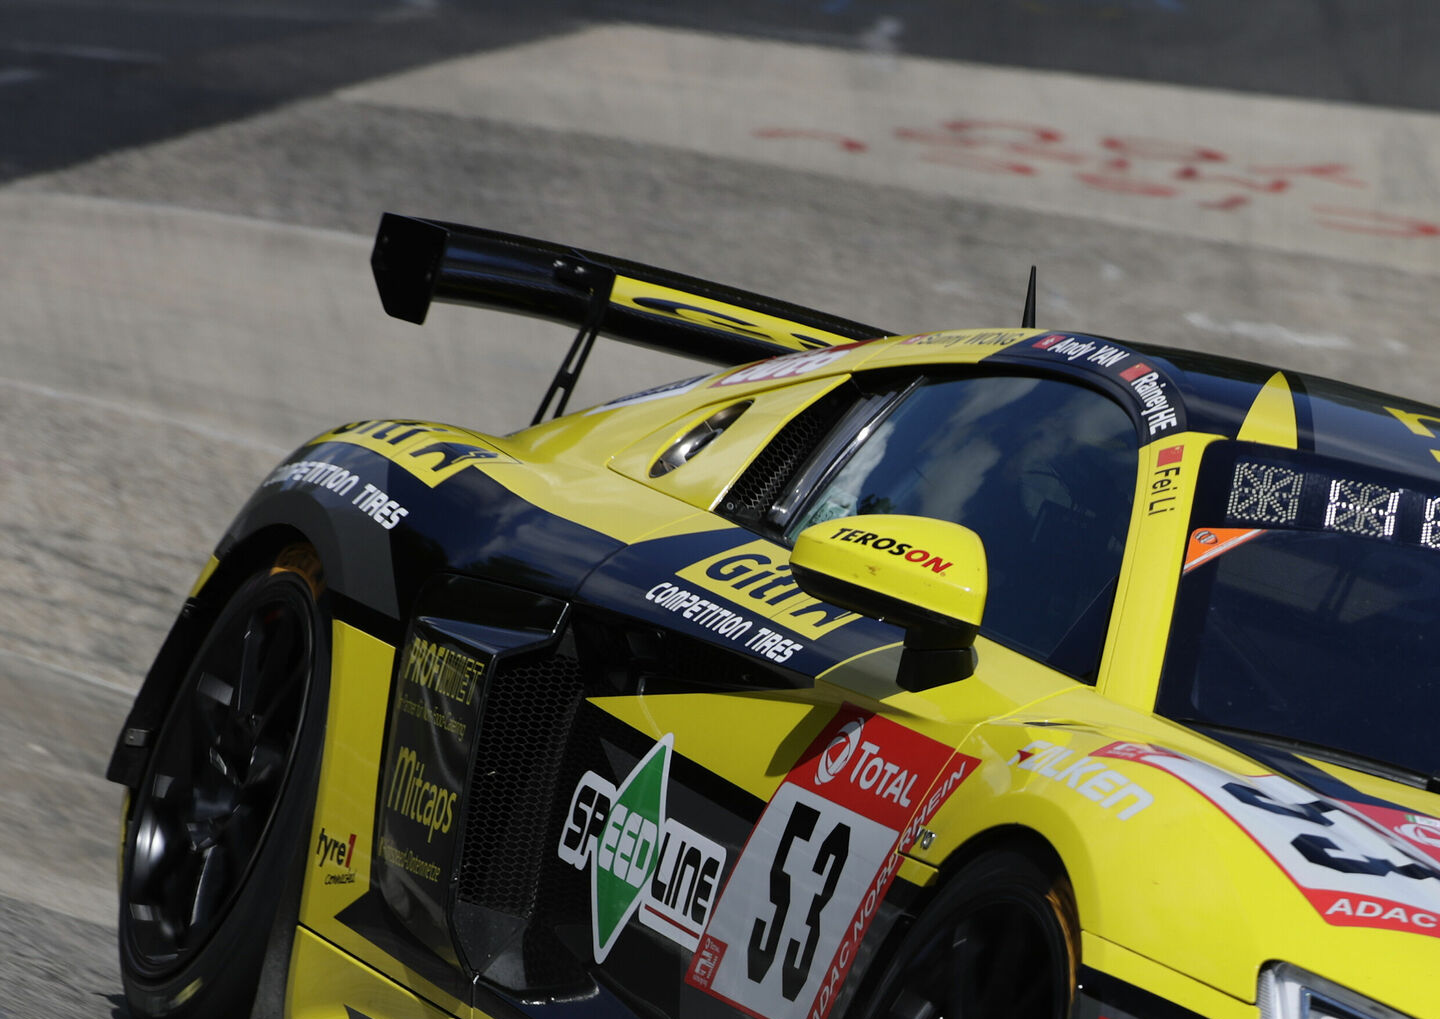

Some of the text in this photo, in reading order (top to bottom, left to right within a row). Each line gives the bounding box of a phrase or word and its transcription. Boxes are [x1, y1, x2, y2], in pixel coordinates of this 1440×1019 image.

[1047, 337, 1130, 368] Andy YAN
[1130, 372, 1178, 435] Rainey HE
[352, 483, 409, 530] TIRES
[1148, 467, 1180, 516] Fei Li
[830, 528, 954, 574] TEROSON
[645, 582, 803, 663] COMPETITION TIRES
[850, 741, 920, 807] TOTAL
[1008, 740, 1154, 821] FALKEN
[747, 801, 851, 1002] 53
[1325, 898, 1437, 928] ADAC
